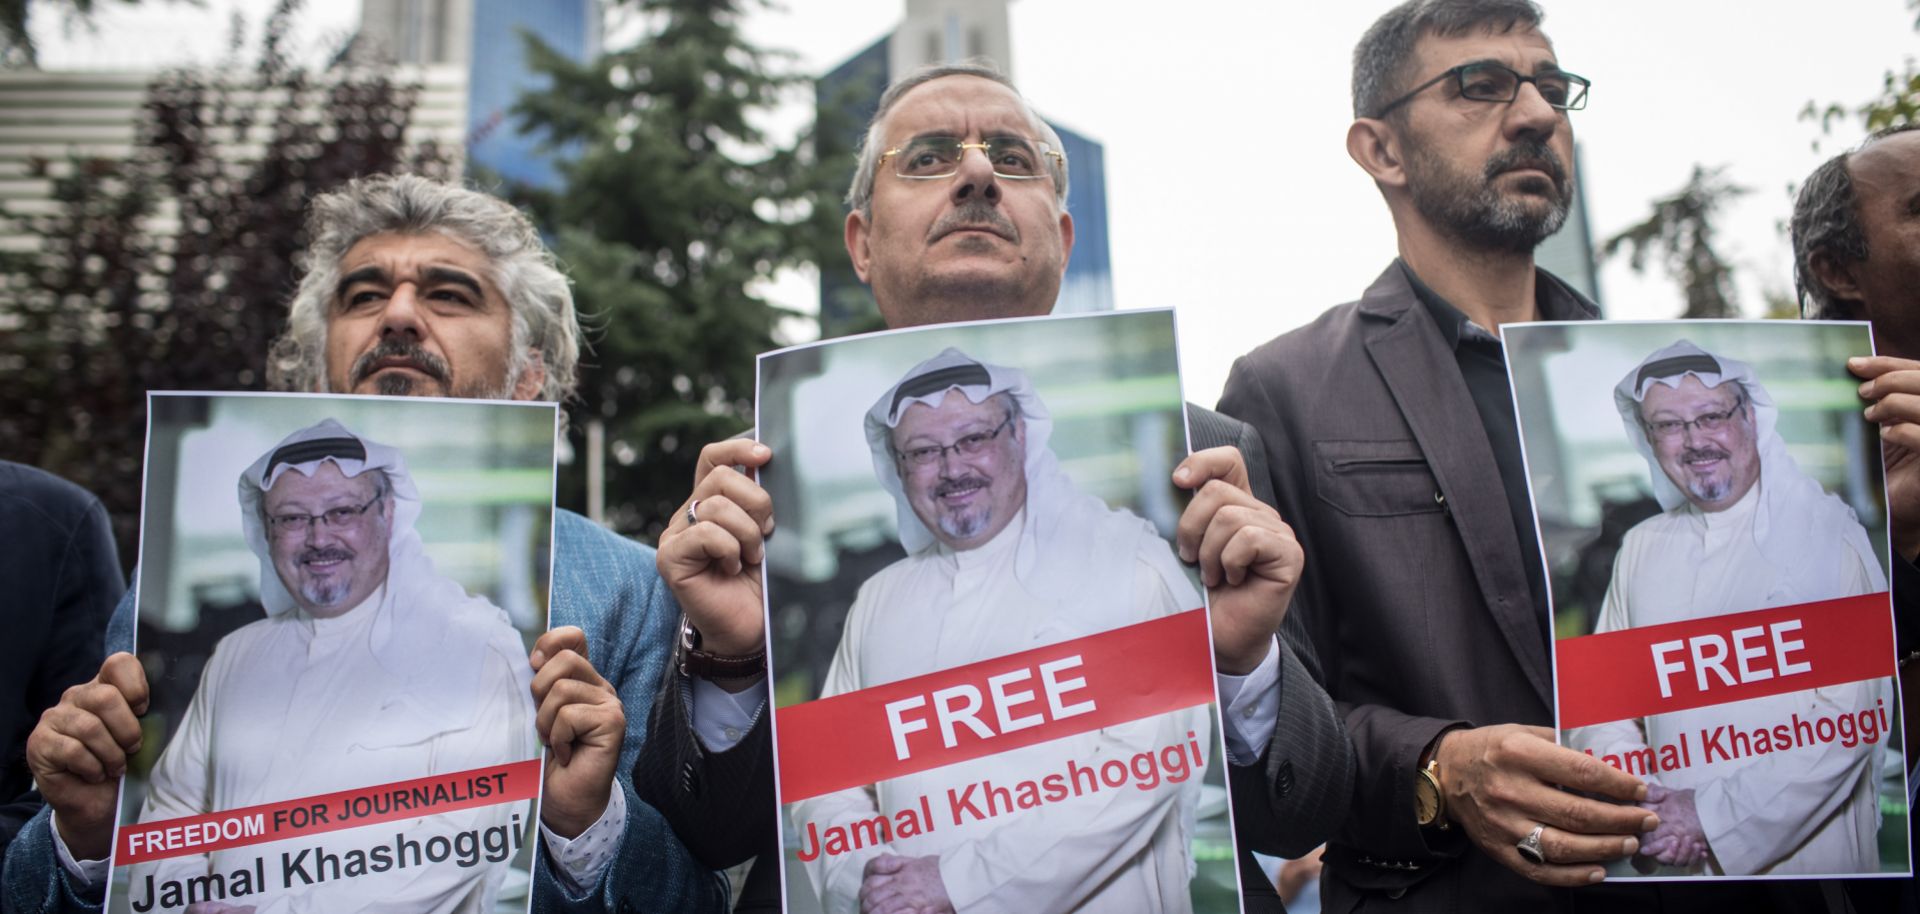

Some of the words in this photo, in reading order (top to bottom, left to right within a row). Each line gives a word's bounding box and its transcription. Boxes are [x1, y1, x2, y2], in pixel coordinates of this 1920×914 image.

[1650, 618, 1812, 699] FREE
[885, 654, 1096, 760] FREE
[1584, 732, 1691, 776] amal
[1701, 699, 1888, 764] Khashoggi
[128, 813, 265, 856] FREEDOM
[273, 803, 330, 832] FOR
[337, 772, 508, 822] JOURNALIST
[797, 795, 934, 863] Jamal
[947, 730, 1204, 826] Khashoggi
[131, 857, 265, 914] Jamal
[282, 813, 524, 889] Khashoggi
